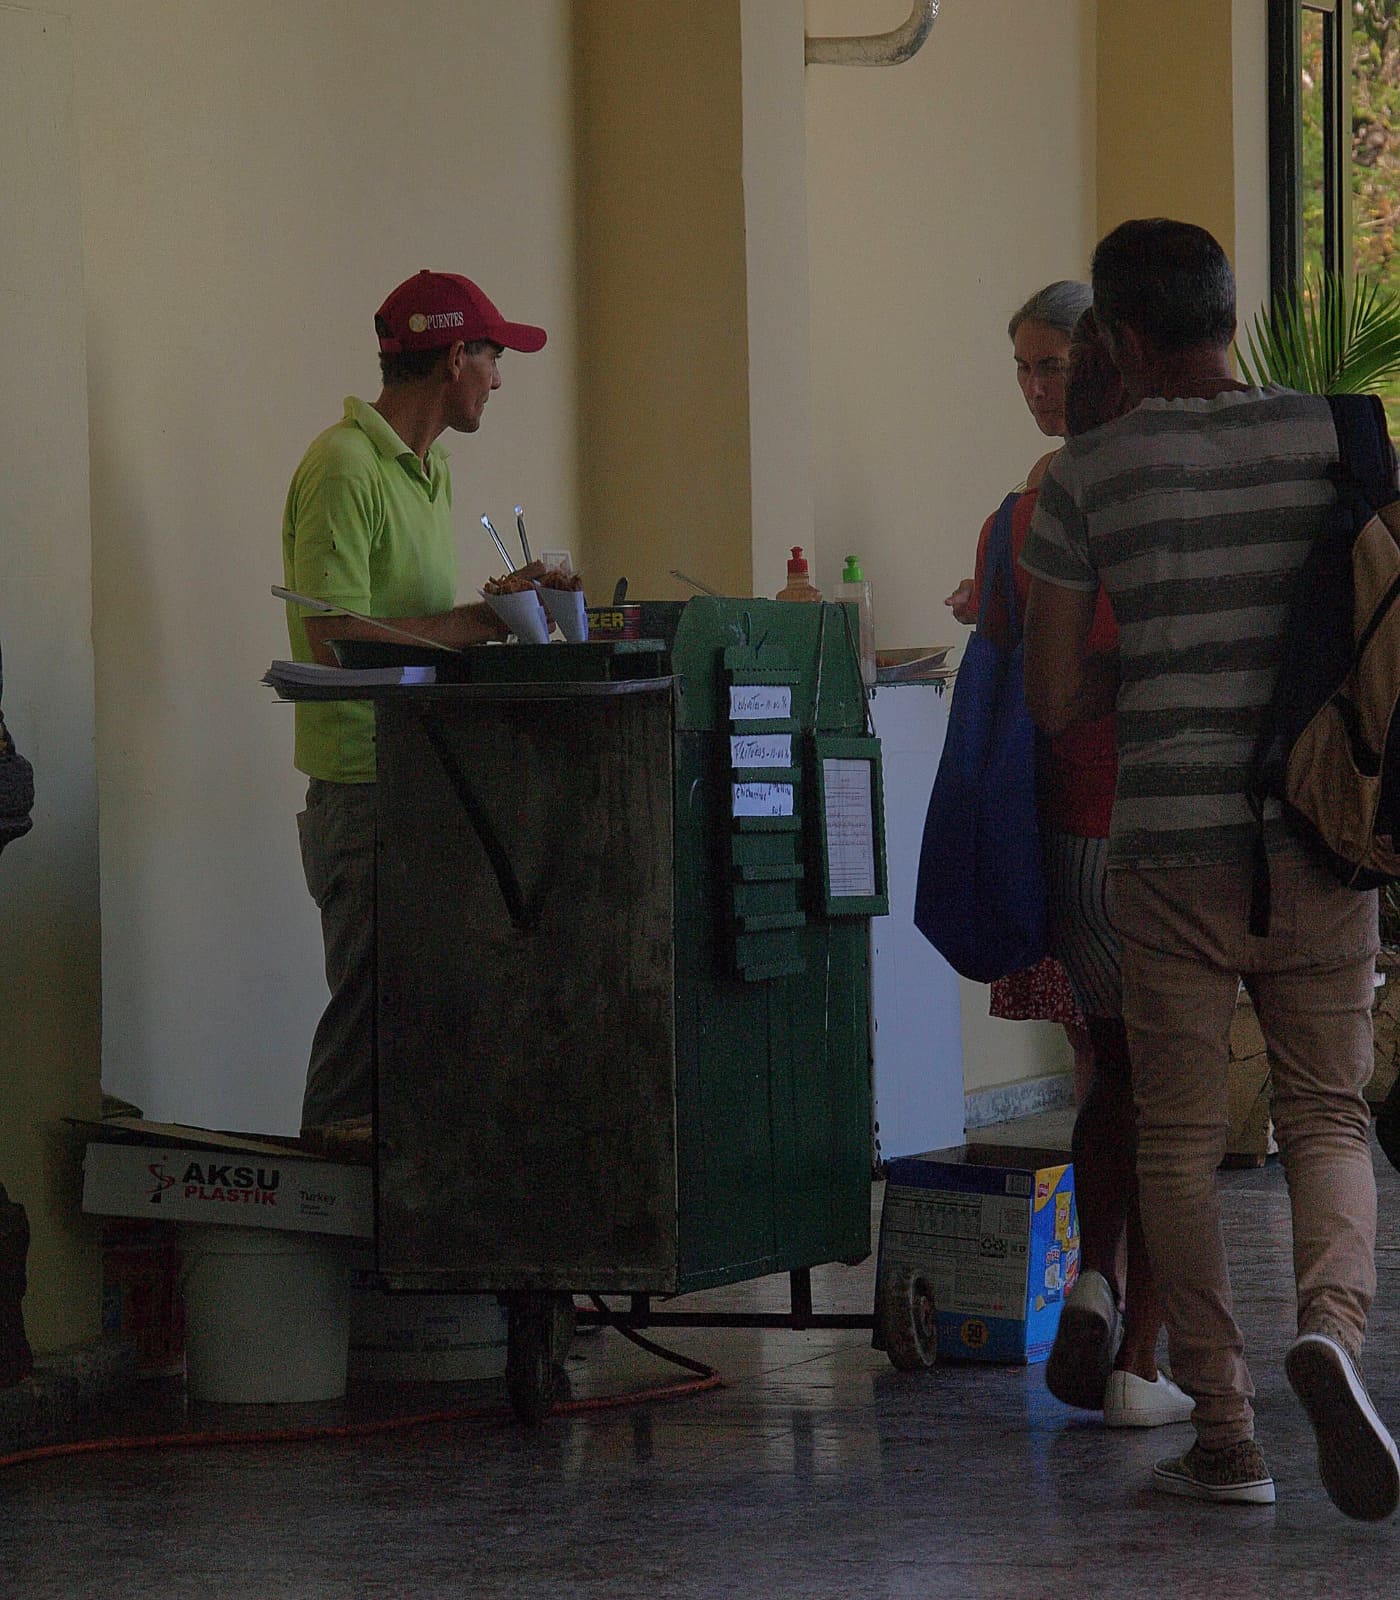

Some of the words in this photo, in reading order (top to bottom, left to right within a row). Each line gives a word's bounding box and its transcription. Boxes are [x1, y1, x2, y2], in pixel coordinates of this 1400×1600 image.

[427, 311, 464, 330] PUENTES
[183, 1163, 280, 1190] AKSU
[300, 1190, 336, 1206] Turkey
